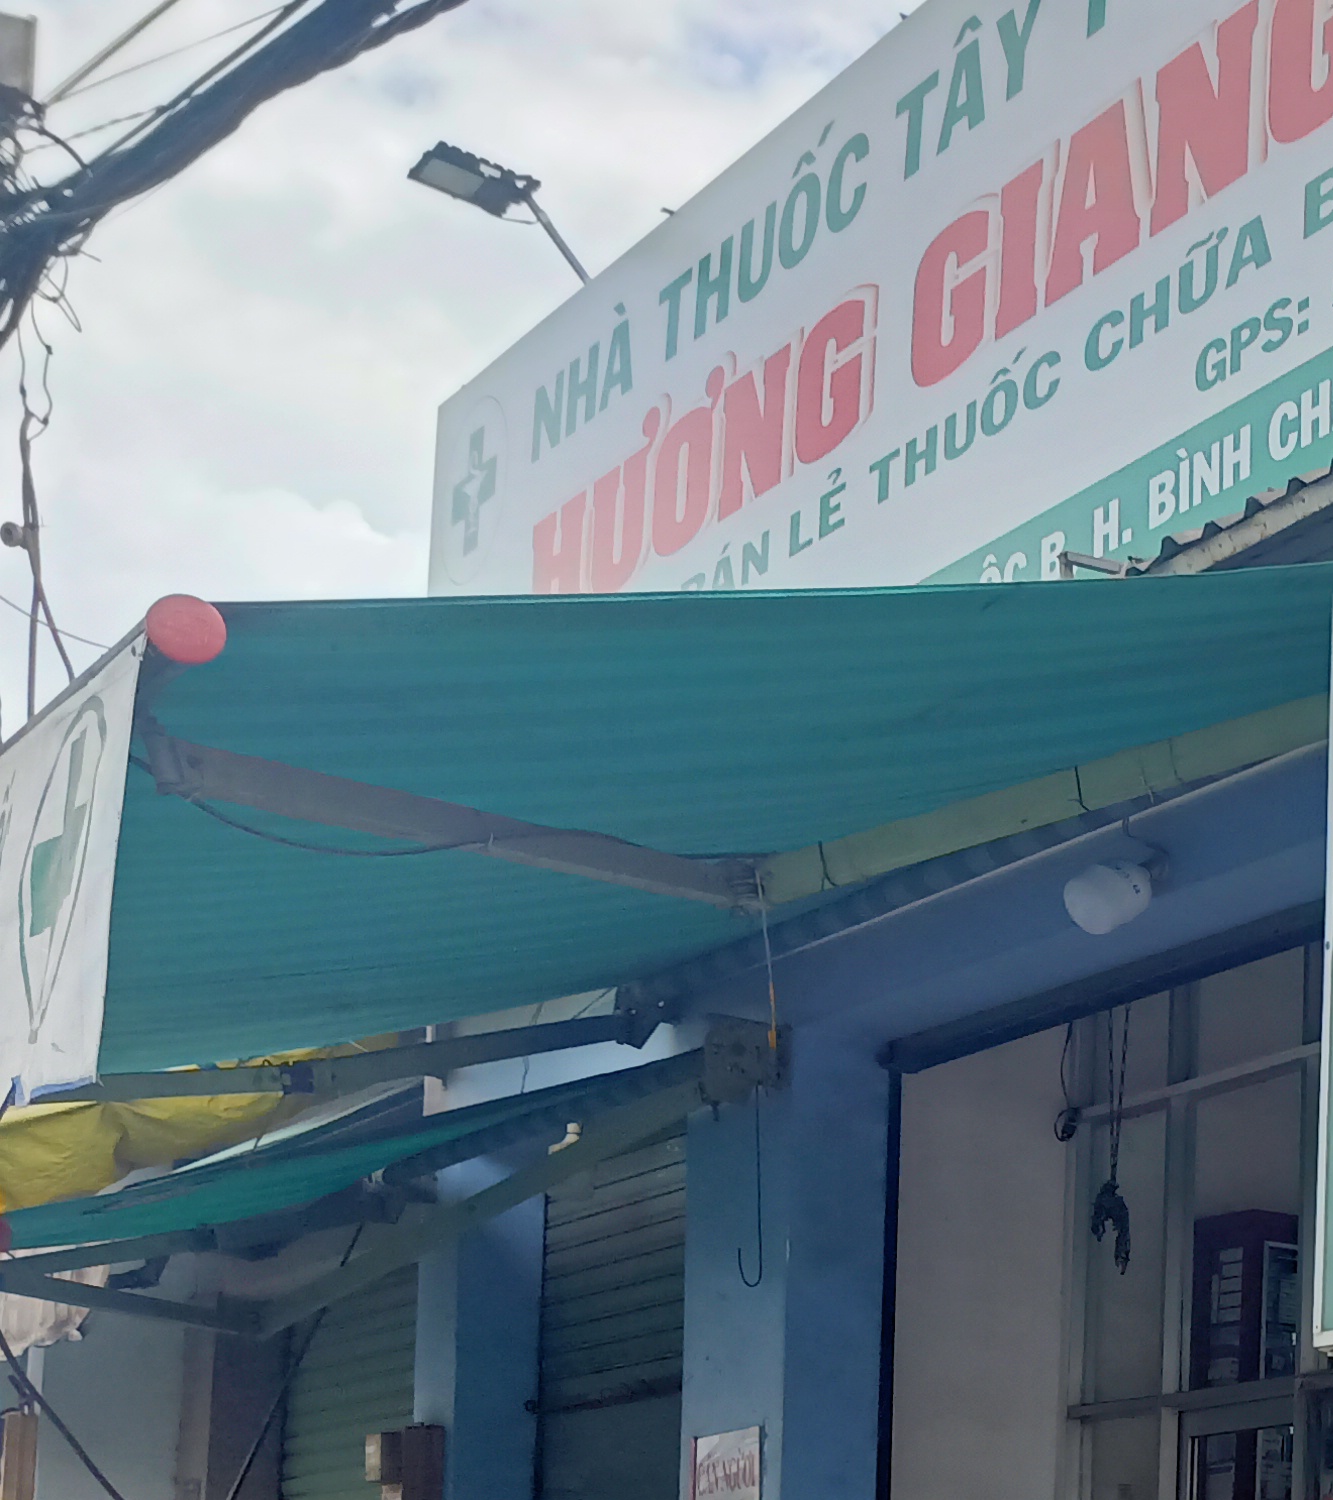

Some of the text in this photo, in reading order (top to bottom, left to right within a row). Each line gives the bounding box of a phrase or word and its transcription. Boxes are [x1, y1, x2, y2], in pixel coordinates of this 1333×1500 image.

[530, 0, 1042, 464] NHÀ THUỐC TÂY
[789, 467, 847, 558] LẺ
[868, 347, 1061, 504] THUỐC
[1083, 215, 1272, 372] CHỮA
[1195, 291, 1310, 393] GPS:
[532, 285, 878, 594] HƯƠNG
[1092, 498, 1133, 559] H.
[1148, 427, 1252, 530] BÌNH
